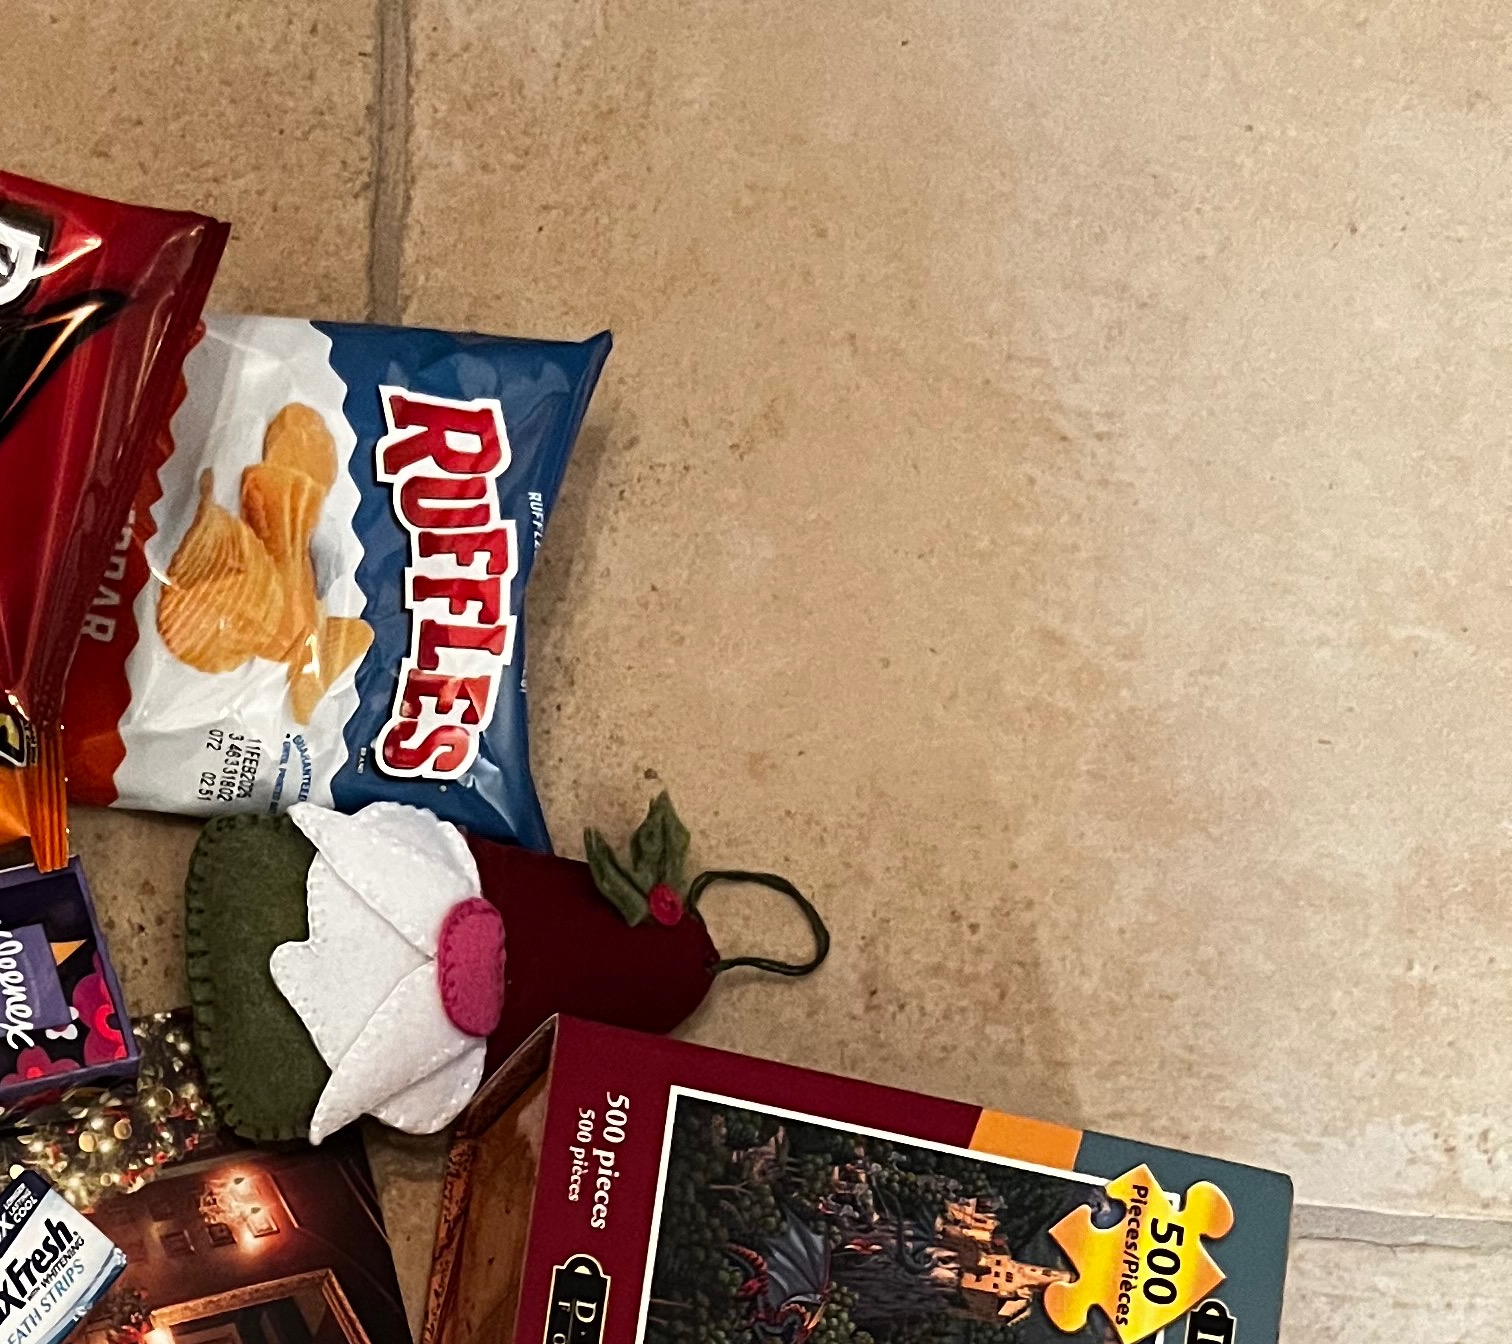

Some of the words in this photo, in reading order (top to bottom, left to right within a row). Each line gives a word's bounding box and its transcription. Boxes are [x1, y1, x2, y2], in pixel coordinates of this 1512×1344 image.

[377, 388, 515, 778] RUFFLES
[206, 728, 223, 750] 072
[576, 1106, 595, 1141] 500
[602, 1092, 630, 1137] 500
[567, 1145, 587, 1202] pièces
[589, 1144, 618, 1230] pieces
[13, 1195, 38, 1223] COOL
[41, 1238, 85, 1289] WHITENING
[1114, 1183, 1149, 1327] Pieces/Pièces
[1143, 1215, 1184, 1305] 500
[41, 1258, 85, 1313] STRIPS
